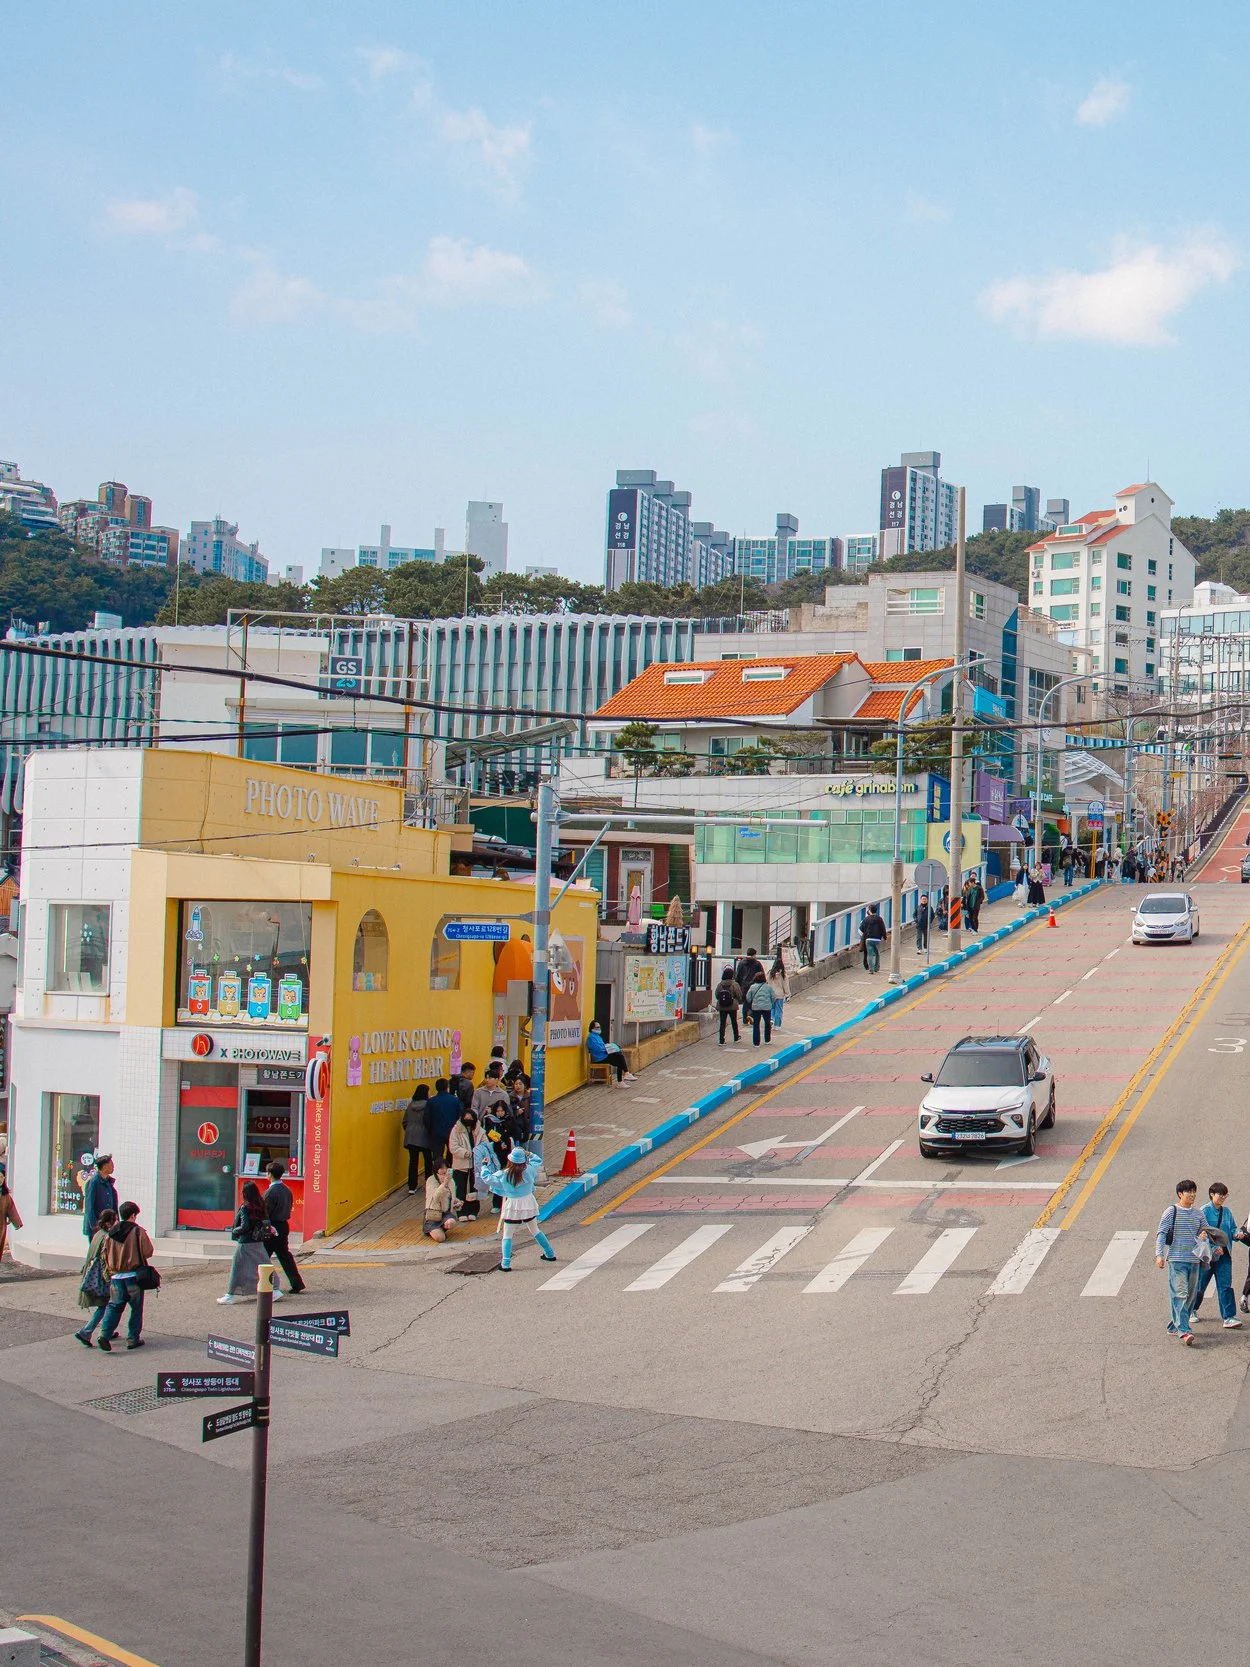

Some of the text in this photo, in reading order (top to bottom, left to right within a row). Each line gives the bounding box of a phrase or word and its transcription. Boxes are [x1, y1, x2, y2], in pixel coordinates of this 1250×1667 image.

[336, 660, 357, 675] GS
[336, 677, 357, 688] 25
[824, 779, 855, 798] café
[244, 777, 381, 832] PHOTO WAVE
[361, 1027, 453, 1055] LOVE IS GIVING
[550, 1026, 581, 1041] PHOTO WAVE
[232, 1048, 301, 1062] PHOTOWAVE
[368, 1056, 444, 1085] HEART BEAR
[313, 1099, 324, 1193] akes you chap, chap!
[181, 1377, 240, 1387] 청사포 쌍둥이 등대
